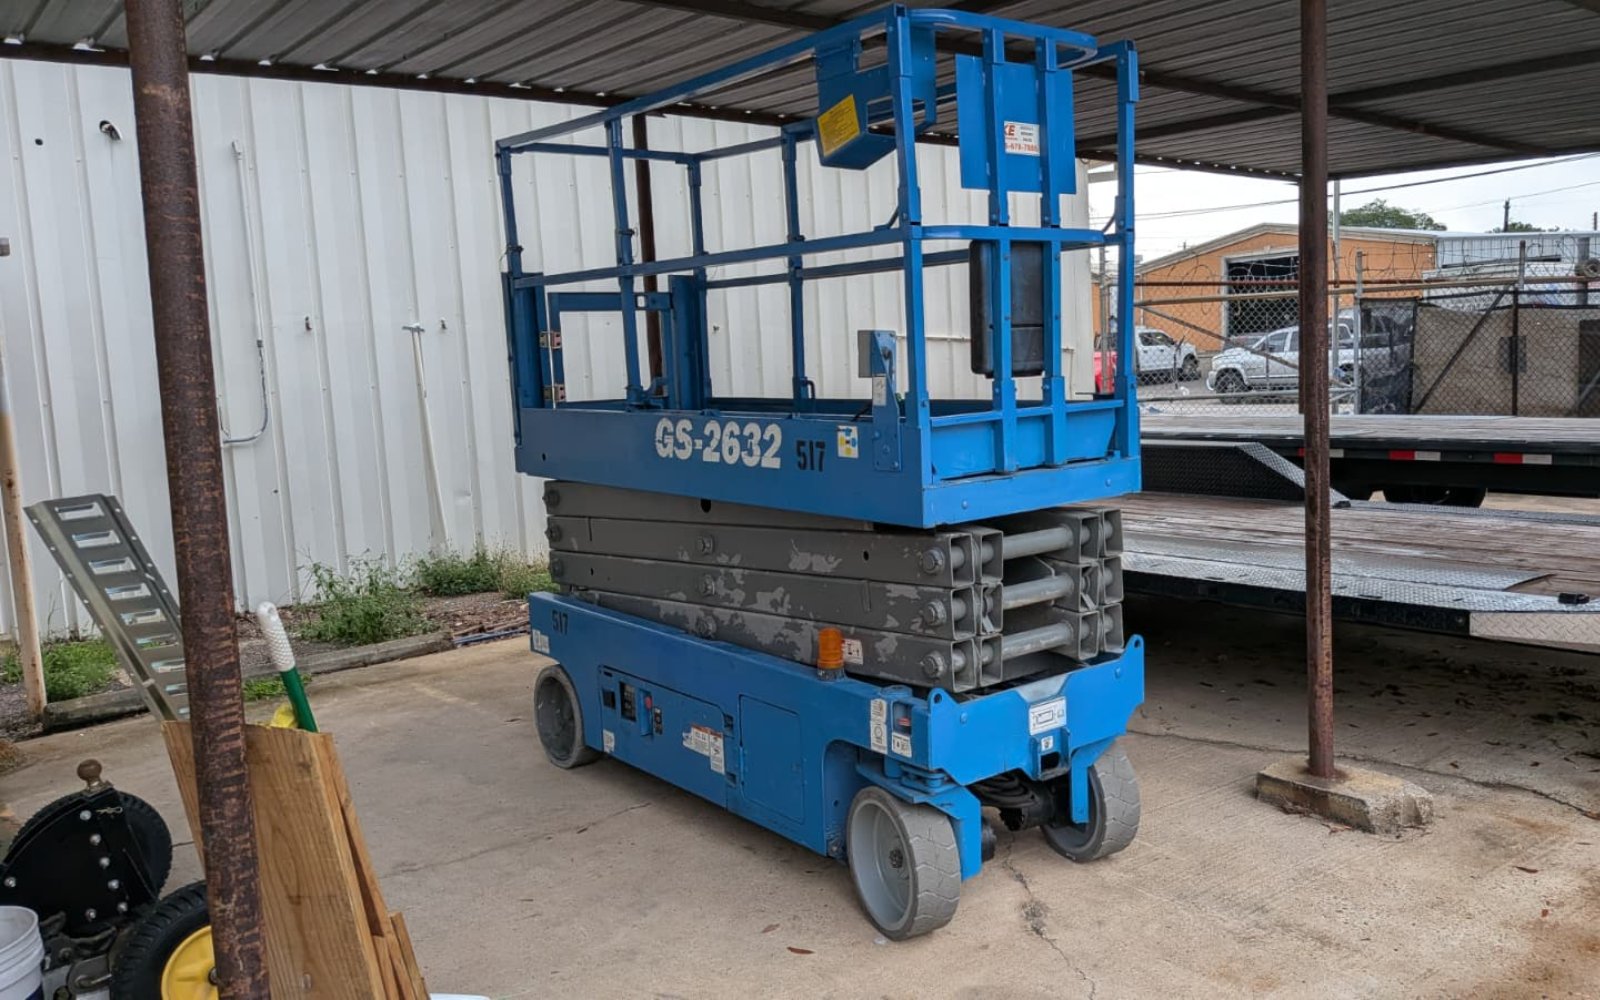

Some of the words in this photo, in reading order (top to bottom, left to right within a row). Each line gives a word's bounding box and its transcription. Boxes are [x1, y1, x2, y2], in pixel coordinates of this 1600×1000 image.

[655, 417, 783, 469] GS-2632
[796, 440, 826, 472] 517
[552, 609, 569, 635] 517
